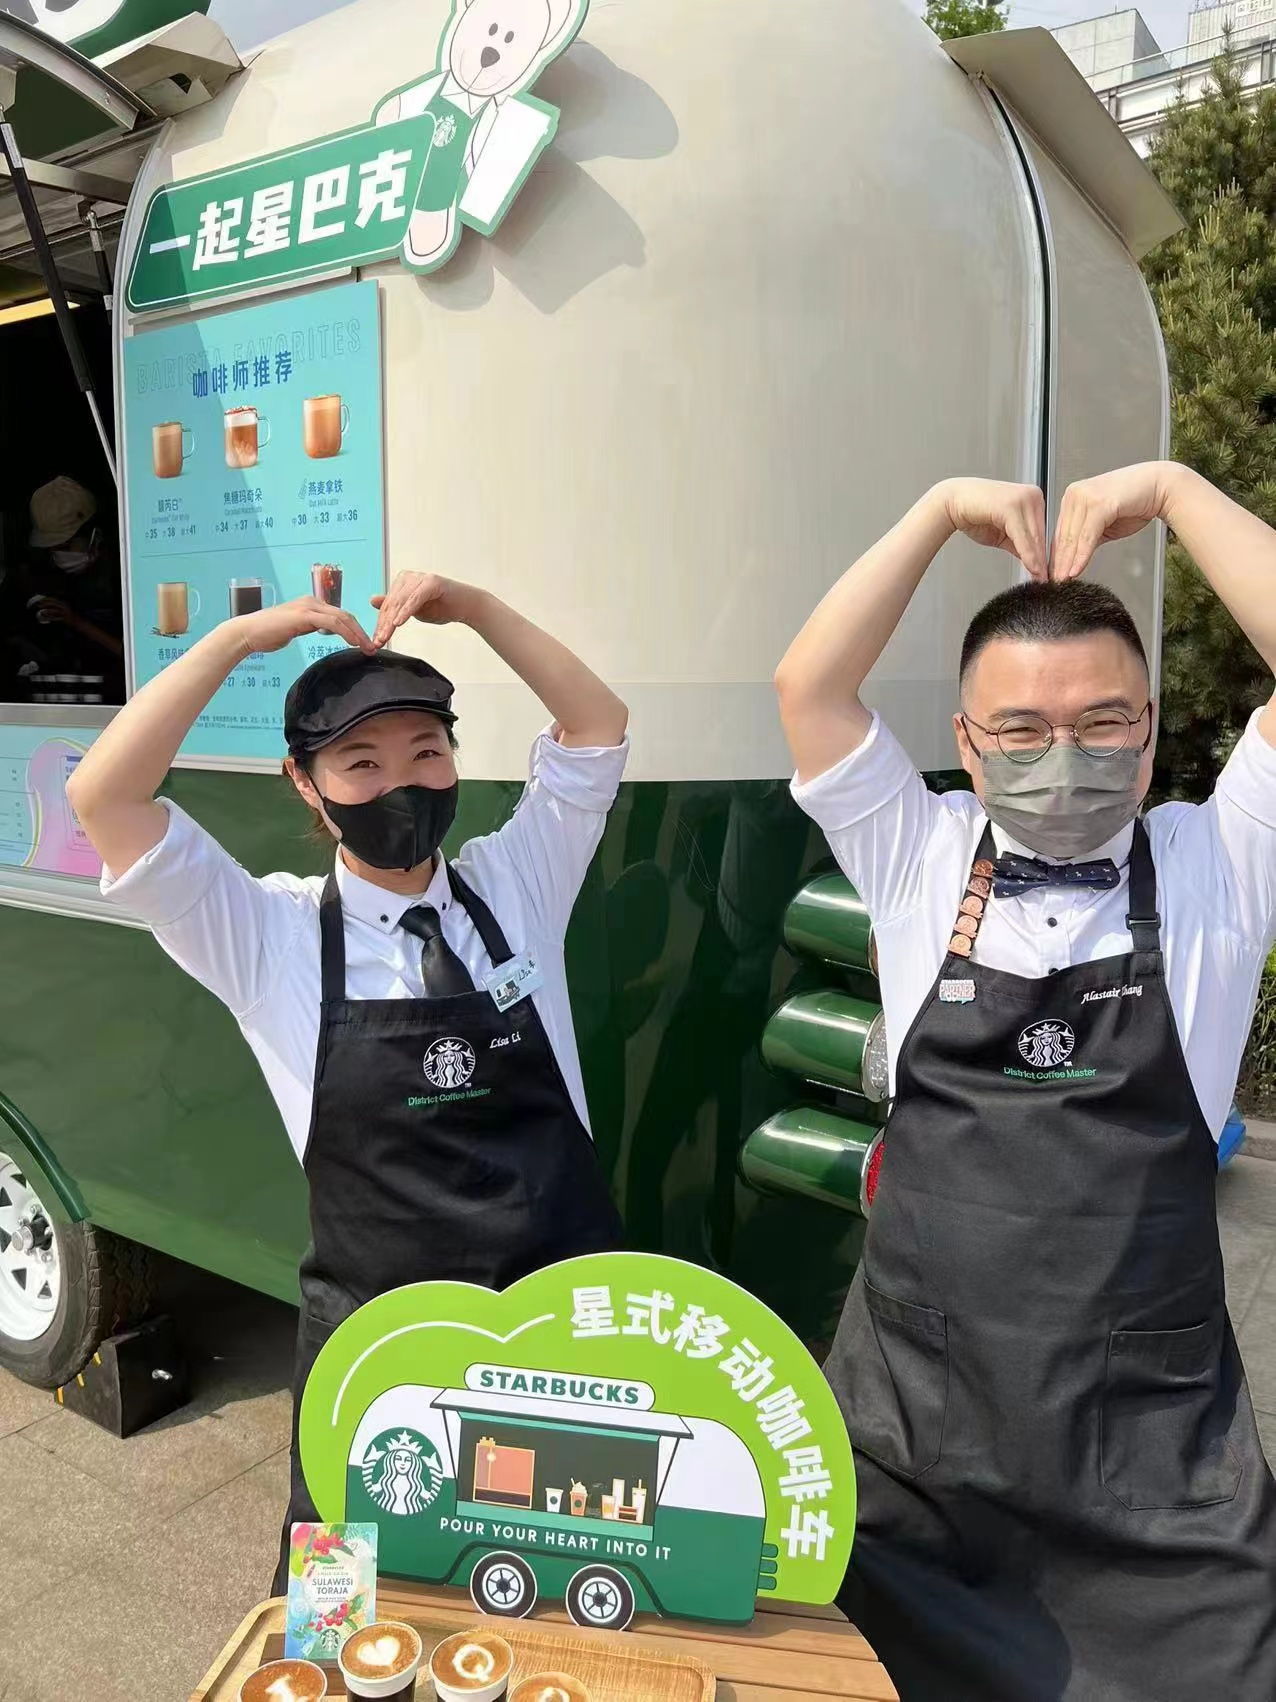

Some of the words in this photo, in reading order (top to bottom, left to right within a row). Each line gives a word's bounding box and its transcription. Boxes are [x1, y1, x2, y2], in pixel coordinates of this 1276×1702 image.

[149, 147, 414, 271] 一起星巴克
[233, 319, 361, 367] FAVORITES
[192, 351, 293, 398] 咖啡师推荐
[308, 479, 343, 496] 燕麦拿铁
[224, 488, 262, 505] 焦糖玛奇朵
[1080, 988, 1121, 1005] Alastair
[489, 1037, 510, 1049] Lisa
[511, 1032, 522, 1043] Li
[1003, 1067, 1035, 1080] District
[1036, 1069, 1066, 1080] Coffee
[1066, 1067, 1097, 1079] Master
[407, 1095, 439, 1106] District
[439, 1092, 466, 1102] Coffee
[466, 1088, 492, 1098] Master
[479, 1369, 640, 1405] STARBUCKS
[570, 1285, 835, 1561] 星式移动咖啡车
[440, 1517, 485, 1535] POUR
[492, 1524, 537, 1542] YOUR
[545, 1531, 599, 1551] HEART
[606, 1539, 648, 1557] INTO
[655, 1545, 672, 1561] IT
[312, 1577, 353, 1586] SULAWESI
[317, 1587, 349, 1595] TORAJA
